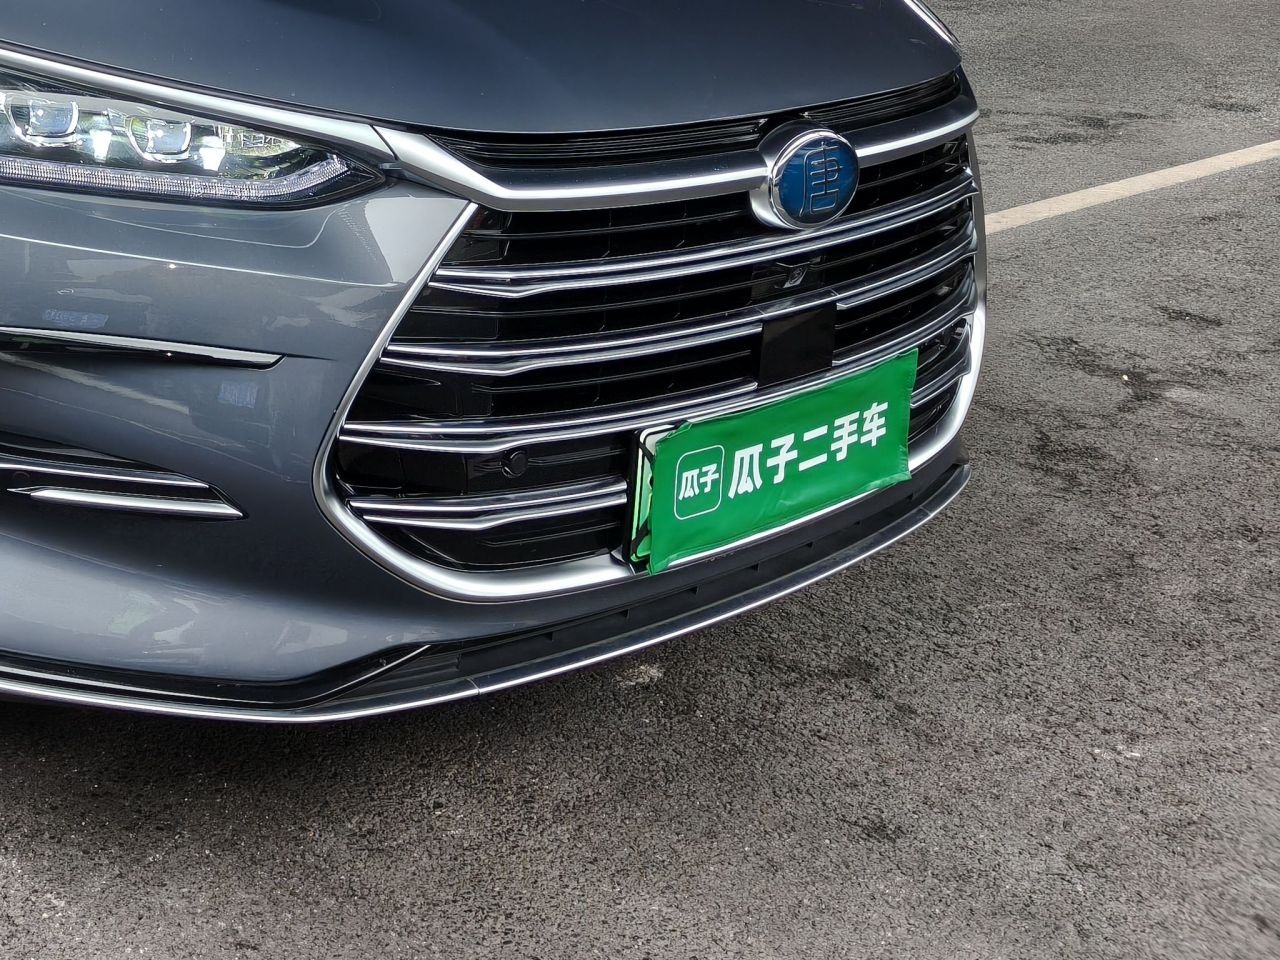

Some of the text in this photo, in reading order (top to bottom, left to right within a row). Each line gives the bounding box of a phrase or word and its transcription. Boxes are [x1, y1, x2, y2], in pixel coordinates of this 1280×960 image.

[678, 463, 720, 502] 瓜子
[727, 400, 889, 501] 瓜子二手车
